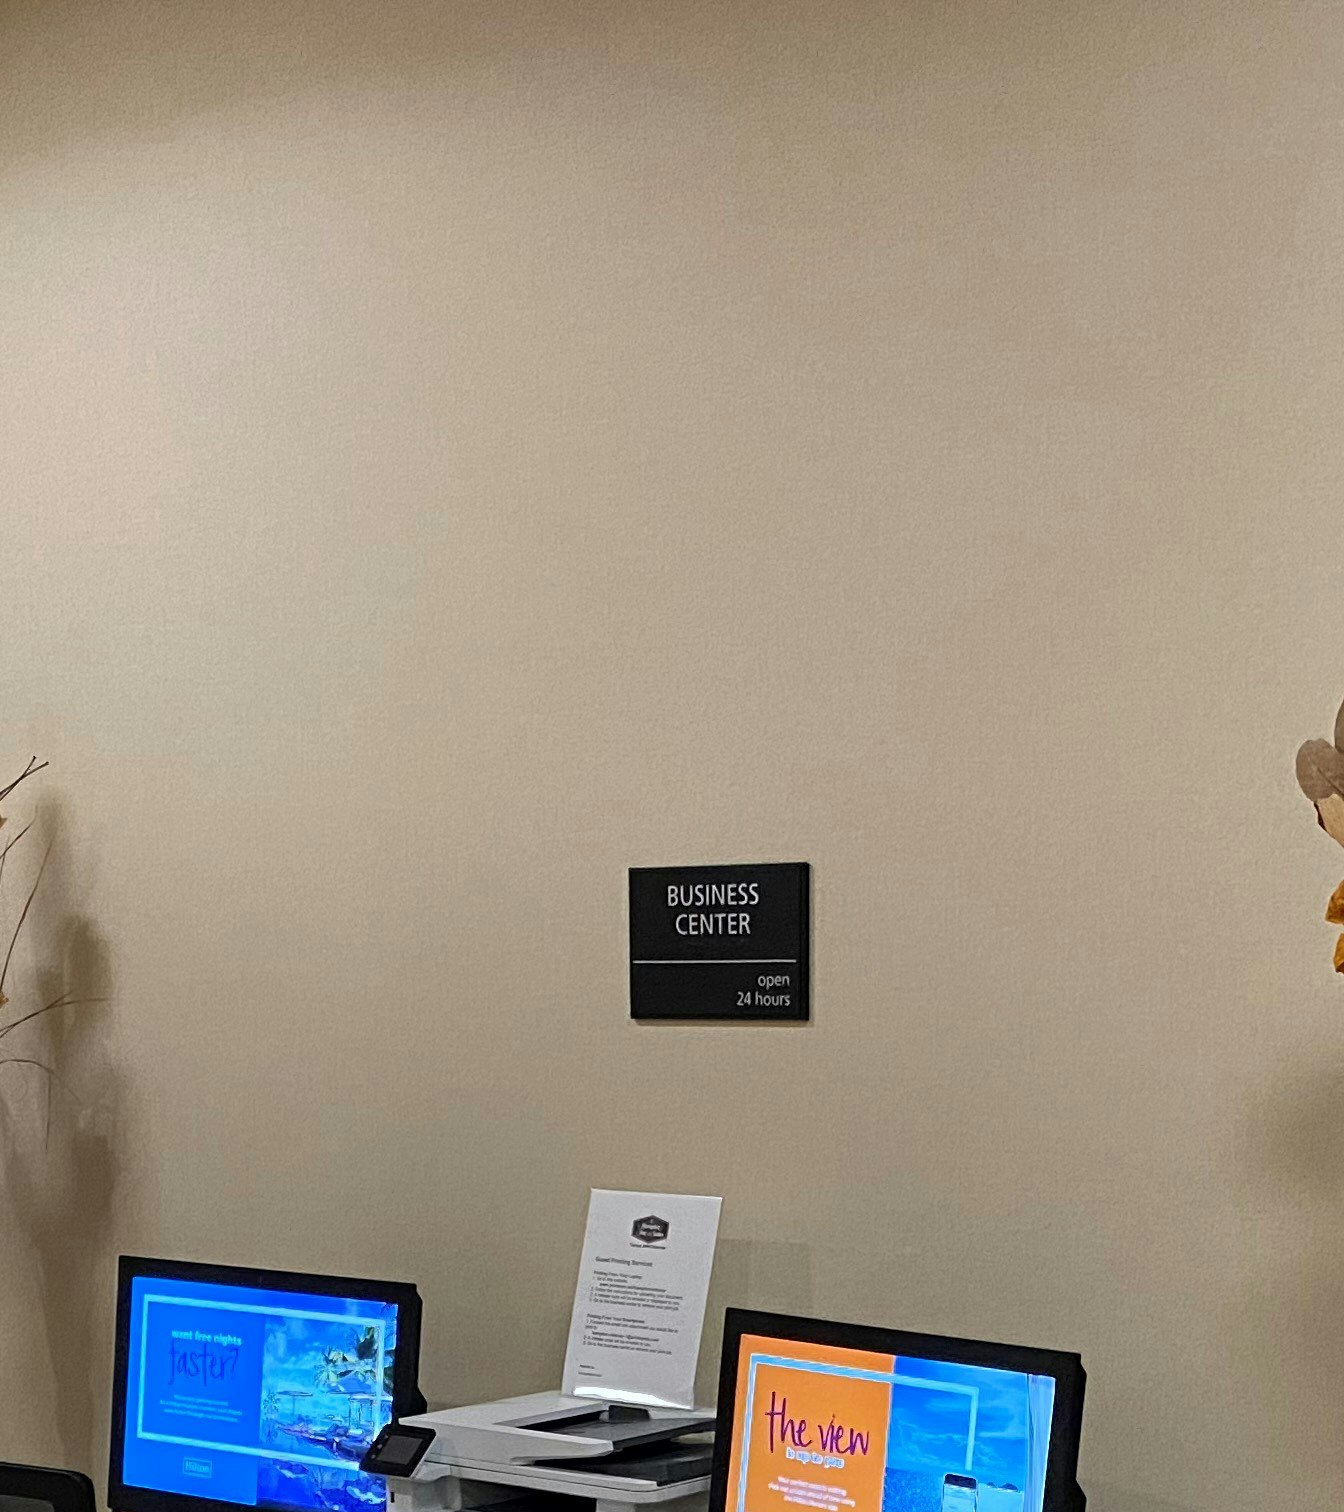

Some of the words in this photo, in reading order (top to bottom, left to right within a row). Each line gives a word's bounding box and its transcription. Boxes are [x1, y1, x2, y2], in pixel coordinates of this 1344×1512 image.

[667, 883, 760, 907] BUSINESS
[675, 913, 751, 935] CENTER
[757, 975, 790, 990] open
[736, 991, 751, 1006] 24
[755, 991, 791, 1006] hours
[194, 1330, 212, 1343] free
[213, 1333, 242, 1347] nights
[765, 1392, 812, 1454] the
[818, 1413, 870, 1456] view
